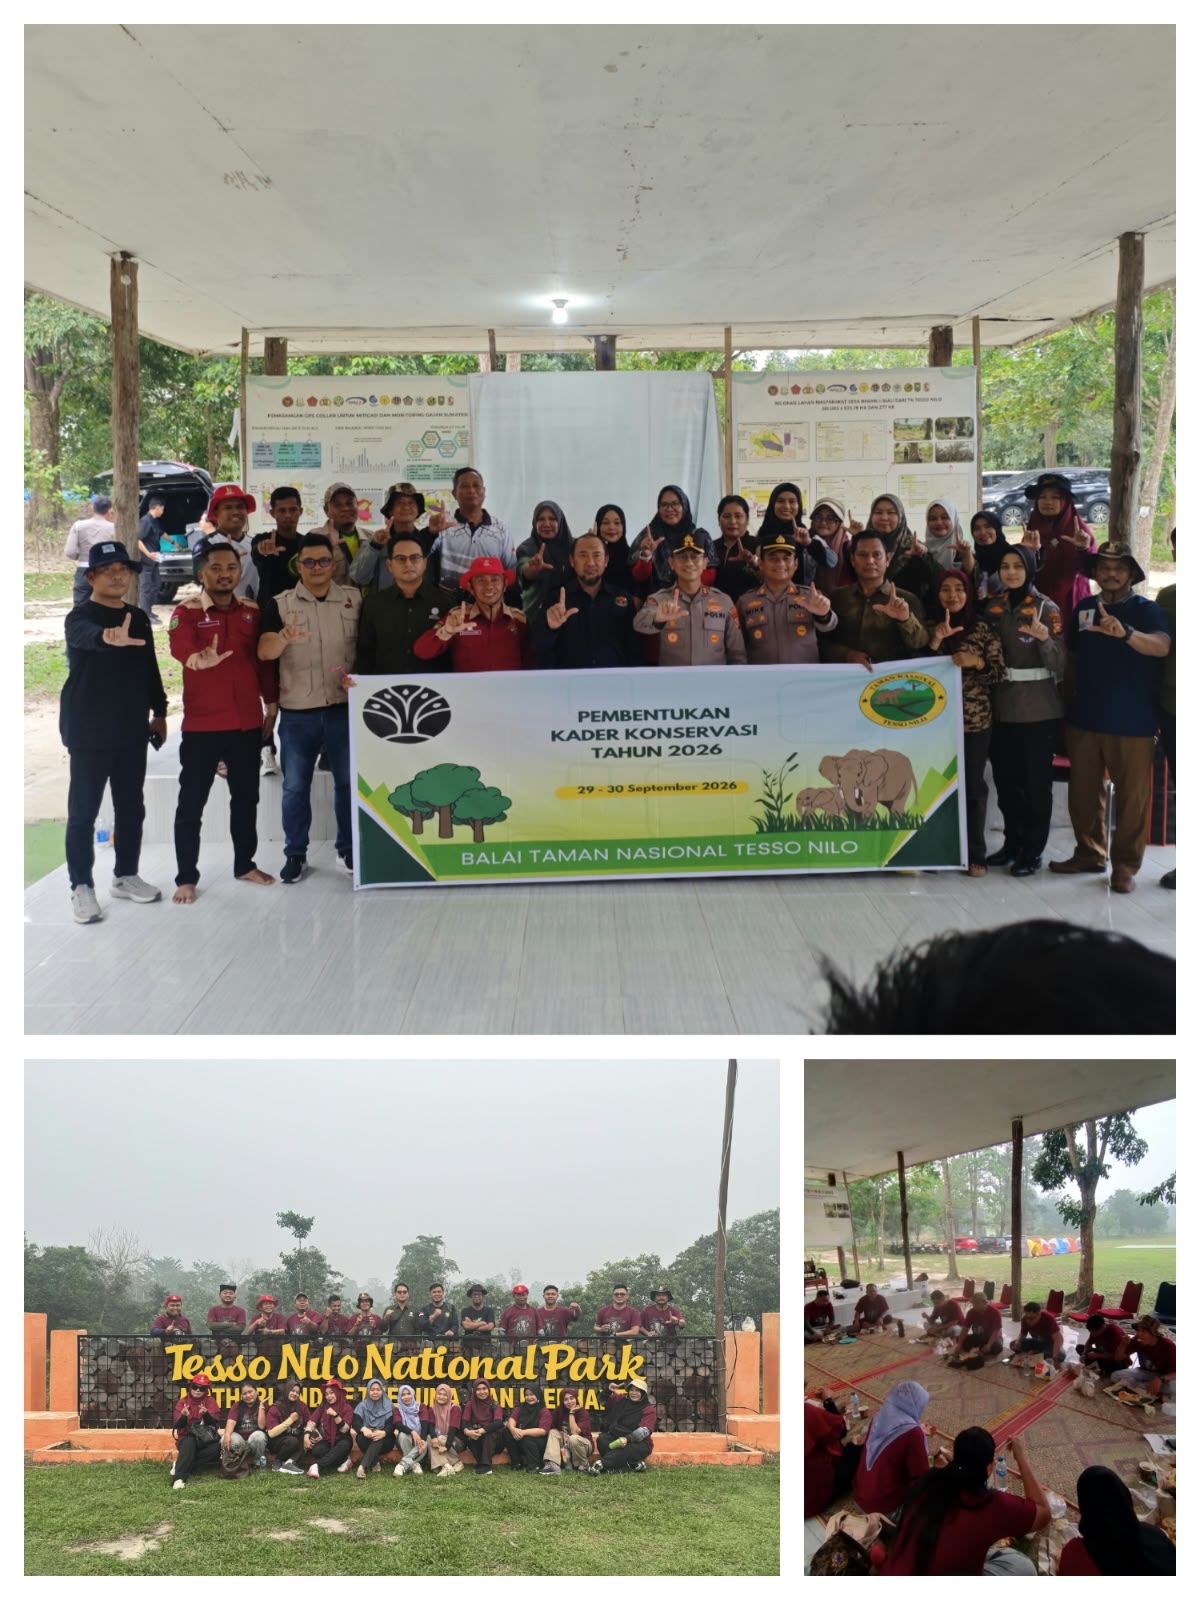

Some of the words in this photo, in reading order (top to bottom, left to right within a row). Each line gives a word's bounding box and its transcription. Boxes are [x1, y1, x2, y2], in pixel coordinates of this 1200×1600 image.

[577, 706, 731, 723] PEMBENTUKAN
[550, 728, 620, 742] KADER
[624, 724, 758, 740] KONSERVASI
[591, 746, 662, 759] TAHUN
[667, 743, 723, 757] 2026
[577, 785, 595, 794] 29
[607, 784, 624, 794] 30
[627, 782, 698, 793] September
[701, 781, 738, 791] 2026
[461, 851, 522, 866] BALAI
[528, 848, 609, 863] TAMAN
[616, 844, 727, 861] NASIONAL
[733, 841, 801, 856] TESSO
[808, 840, 859, 855] NILO
[164, 1343, 271, 1382] Tesso
[362, 1343, 538, 1381] National
[540, 1343, 647, 1382] Park
